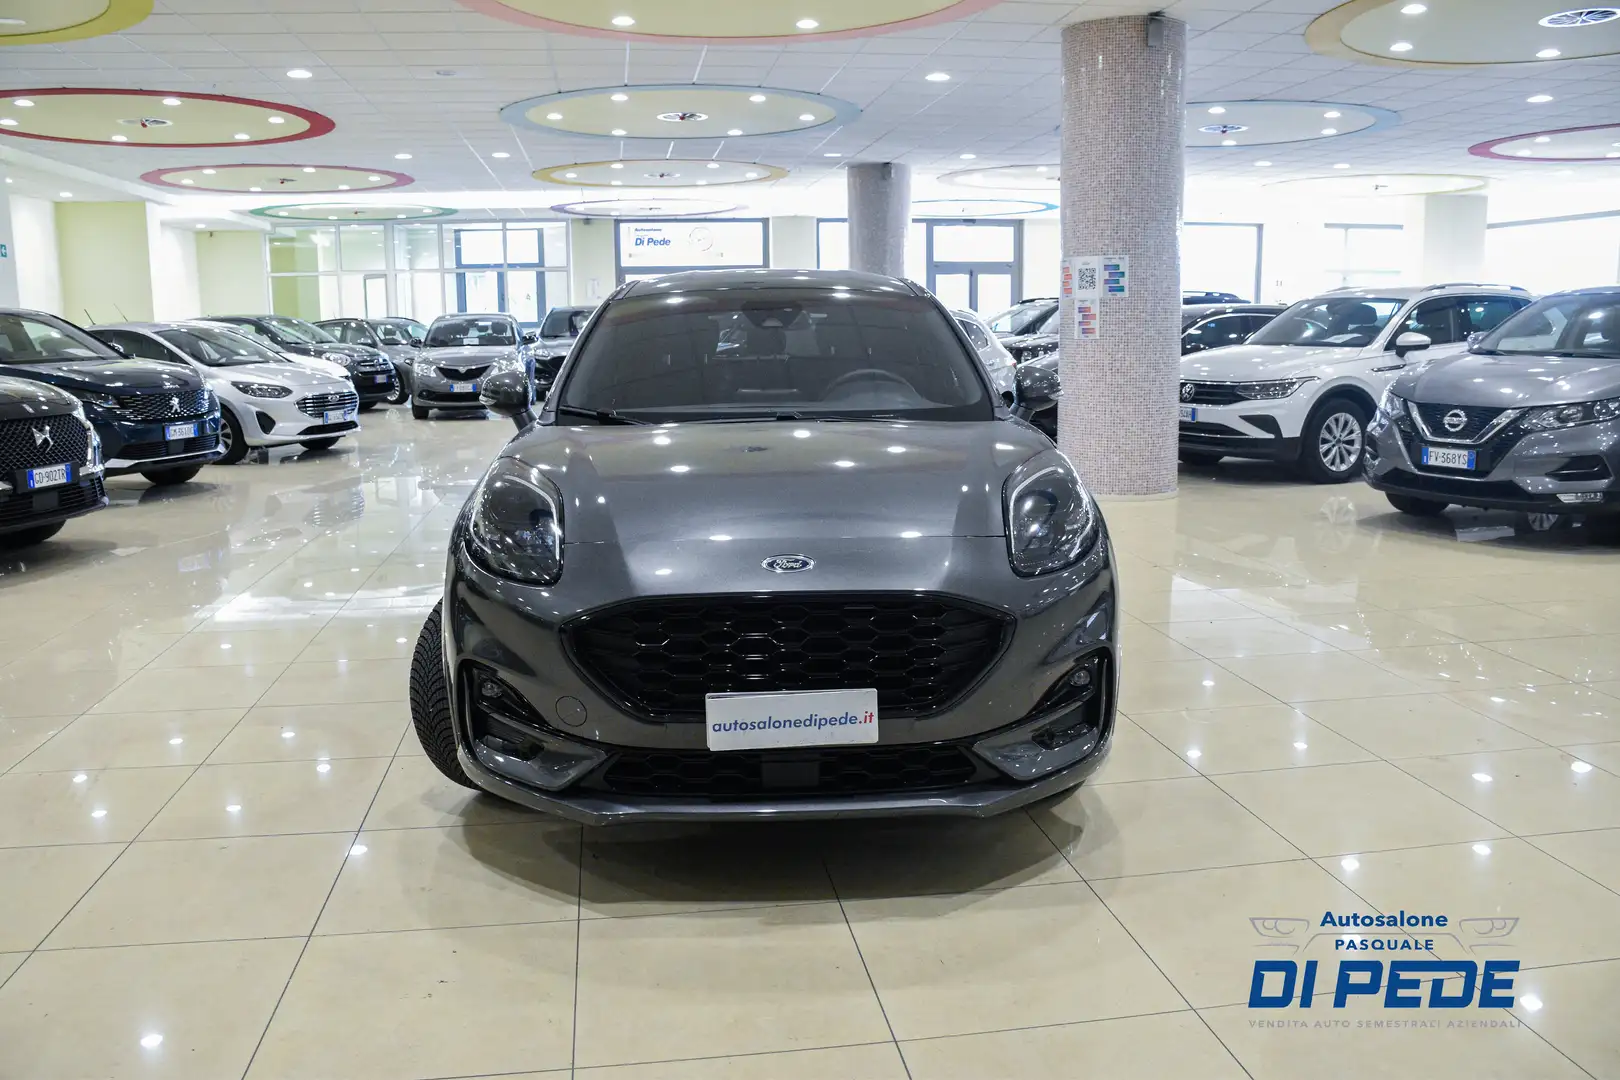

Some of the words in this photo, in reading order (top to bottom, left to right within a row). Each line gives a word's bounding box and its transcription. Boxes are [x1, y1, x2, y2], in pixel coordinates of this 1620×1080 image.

[635, 237, 645, 246] Di
[647, 237, 671, 246] Pede
[773, 558, 803, 570] Ford
[712, 711, 875, 733] autosalonedipede.it
